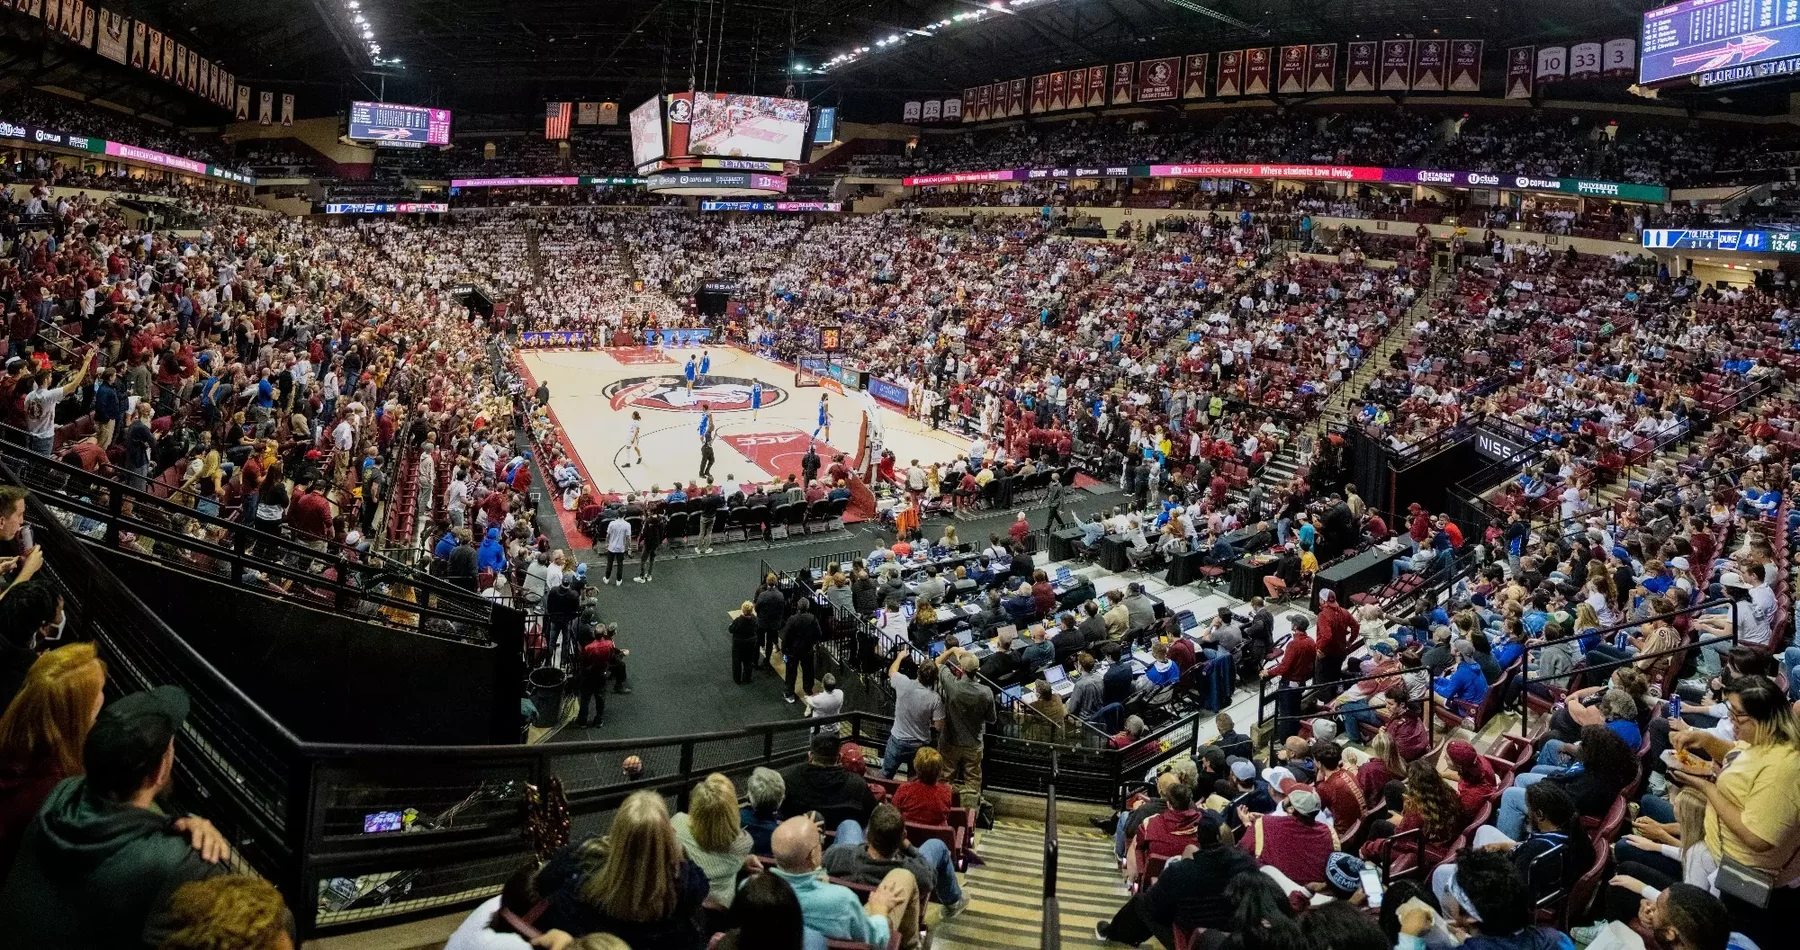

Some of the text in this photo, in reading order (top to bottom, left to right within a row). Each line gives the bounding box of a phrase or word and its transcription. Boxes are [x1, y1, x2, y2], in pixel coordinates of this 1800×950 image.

[1575, 53, 1596, 68] 33
[1613, 50, 1625, 63] 3
[1544, 57, 1561, 71] 10
[1702, 65, 1754, 84] FLORIDA
[1141, 91, 1174, 99] BASKETBALL
[906, 108, 918, 116] 43
[926, 106, 938, 115] 25
[947, 105, 958, 114] 13
[1222, 167, 1254, 175] CAMPUS
[1260, 166, 1282, 175] Where
[1283, 167, 1313, 176] students
[1314, 167, 1329, 175] love
[1529, 180, 1561, 189] COPELAND
[1578, 182, 1619, 191] UNIVERSITY
[1578, 187, 1618, 195] VILLAGE
[1688, 230, 1714, 239] TOL FLS
[1719, 234, 1737, 244] DUKE
[1691, 241, 1712, 249] 3 4
[1745, 233, 1760, 248] 41
[1771, 240, 1797, 251] 13:45
[736, 433, 805, 446] ACC
